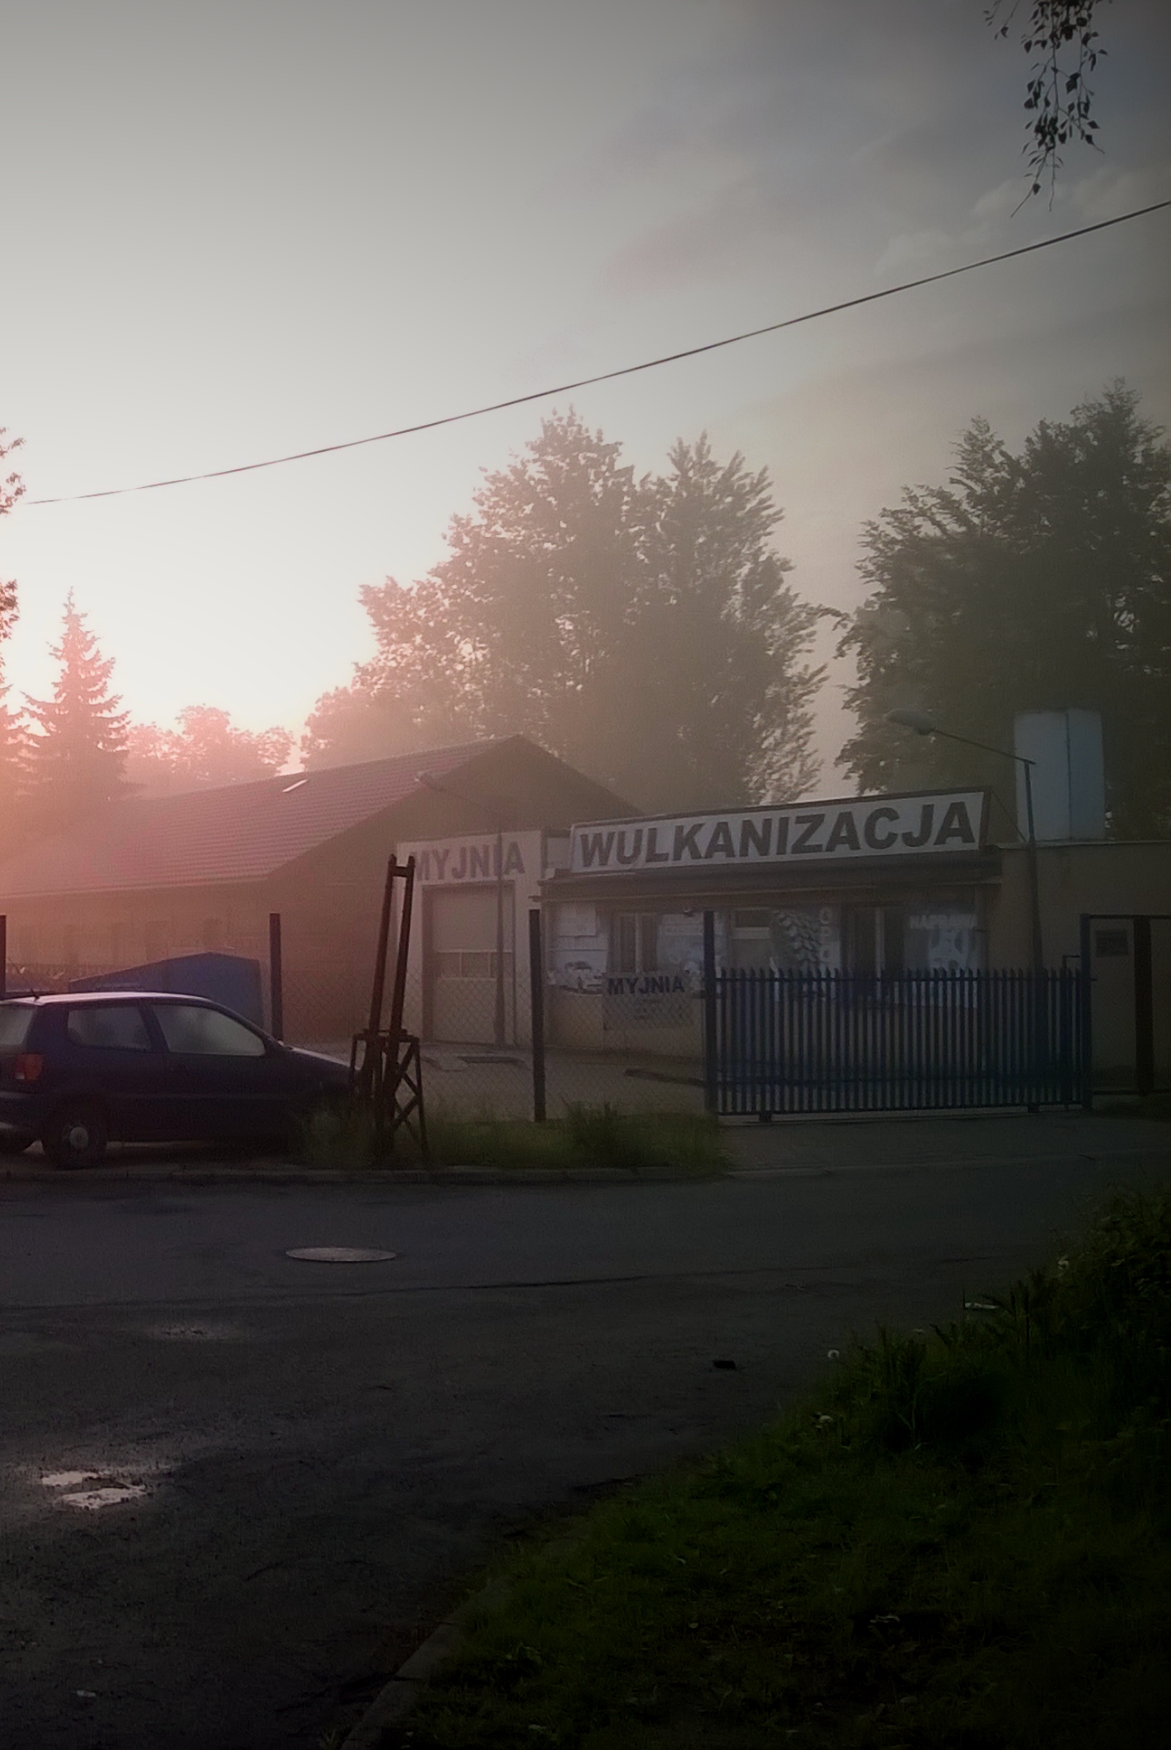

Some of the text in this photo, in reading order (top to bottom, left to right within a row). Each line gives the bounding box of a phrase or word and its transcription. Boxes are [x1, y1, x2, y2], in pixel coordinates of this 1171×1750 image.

[579, 801, 976, 868] WULKANIZACJA
[410, 841, 525, 881] MYJNIA
[607, 975, 686, 995] MYJNIA
